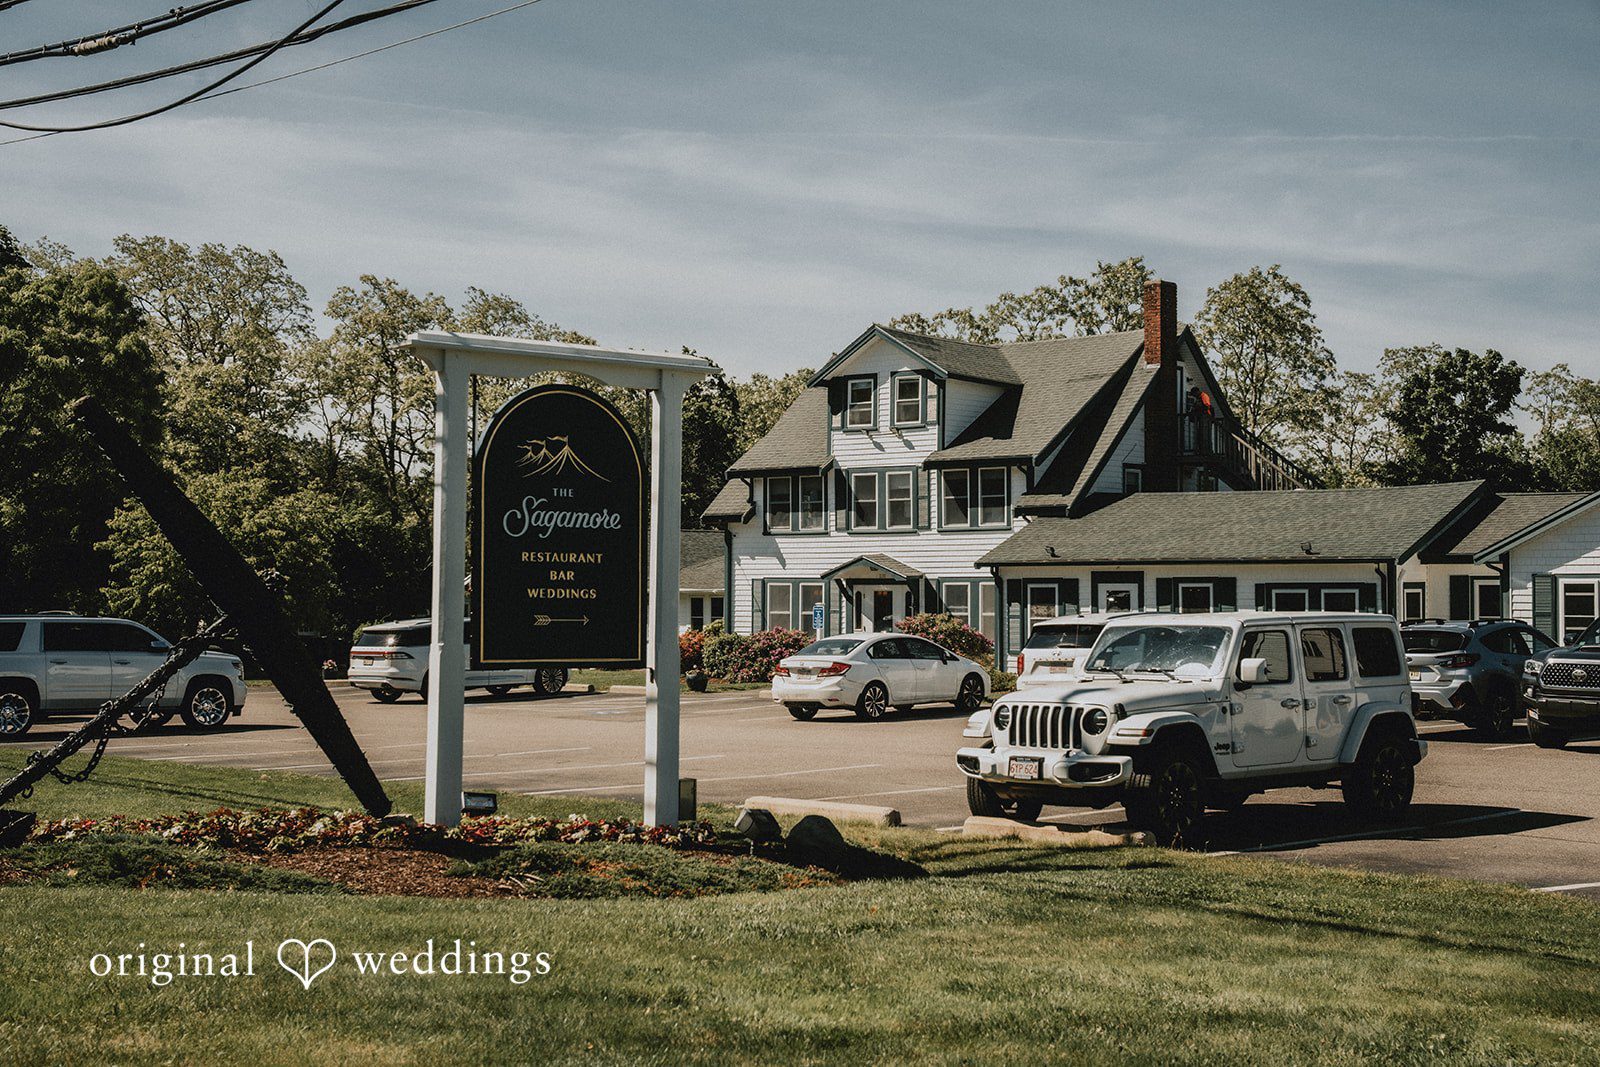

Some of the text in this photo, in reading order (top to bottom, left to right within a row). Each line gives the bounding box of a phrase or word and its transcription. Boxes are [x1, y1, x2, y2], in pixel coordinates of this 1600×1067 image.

[552, 487, 574, 498] THE
[502, 495, 622, 539] Sagamore
[521, 551, 603, 564] RESTAURANT
[549, 570, 575, 581] BAR
[527, 588, 597, 599] WEDDINGS
